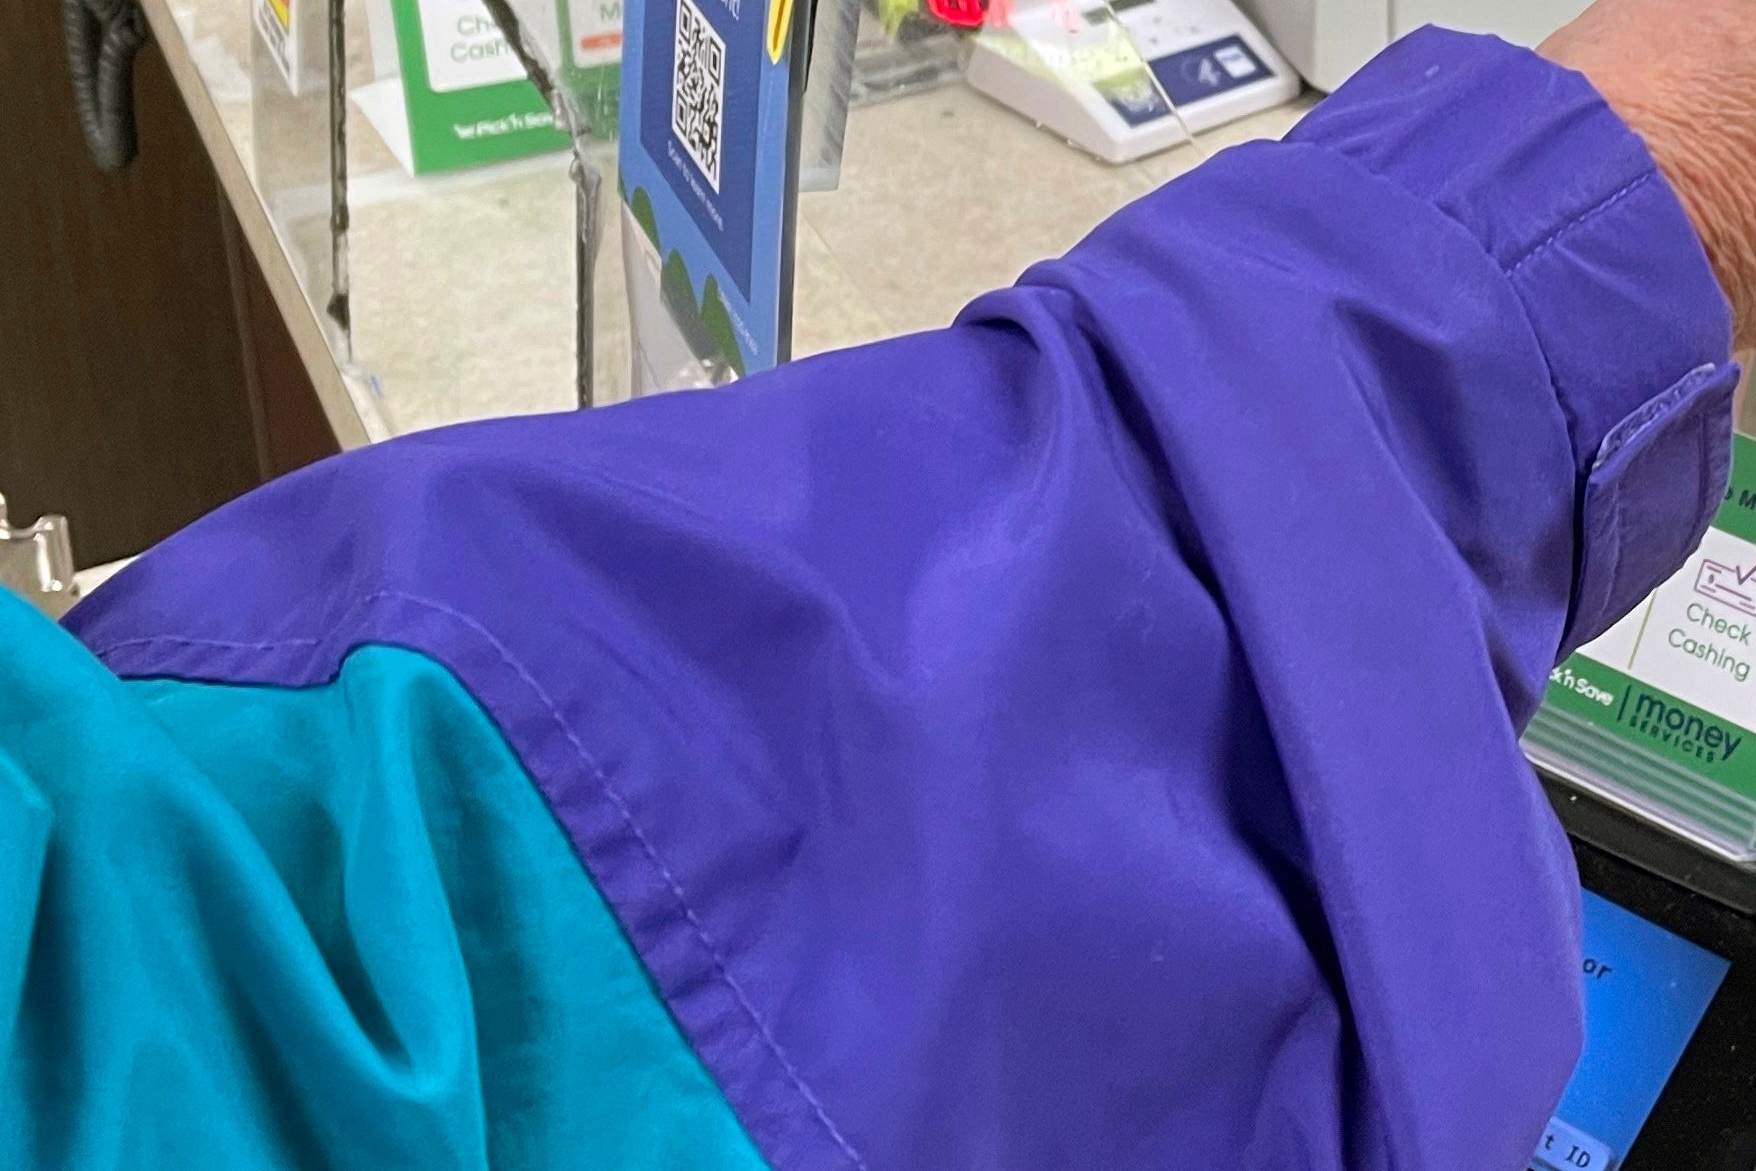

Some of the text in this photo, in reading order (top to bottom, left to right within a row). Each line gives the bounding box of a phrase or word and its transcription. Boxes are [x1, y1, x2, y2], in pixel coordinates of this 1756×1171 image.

[450, 39, 510, 63] Cash
[1686, 602, 1752, 646] Check
[1668, 627, 1751, 683] Cashing
[1575, 678, 1614, 707] Save
[1636, 691, 1742, 763] money
[1565, 1145, 1591, 1168] ID
